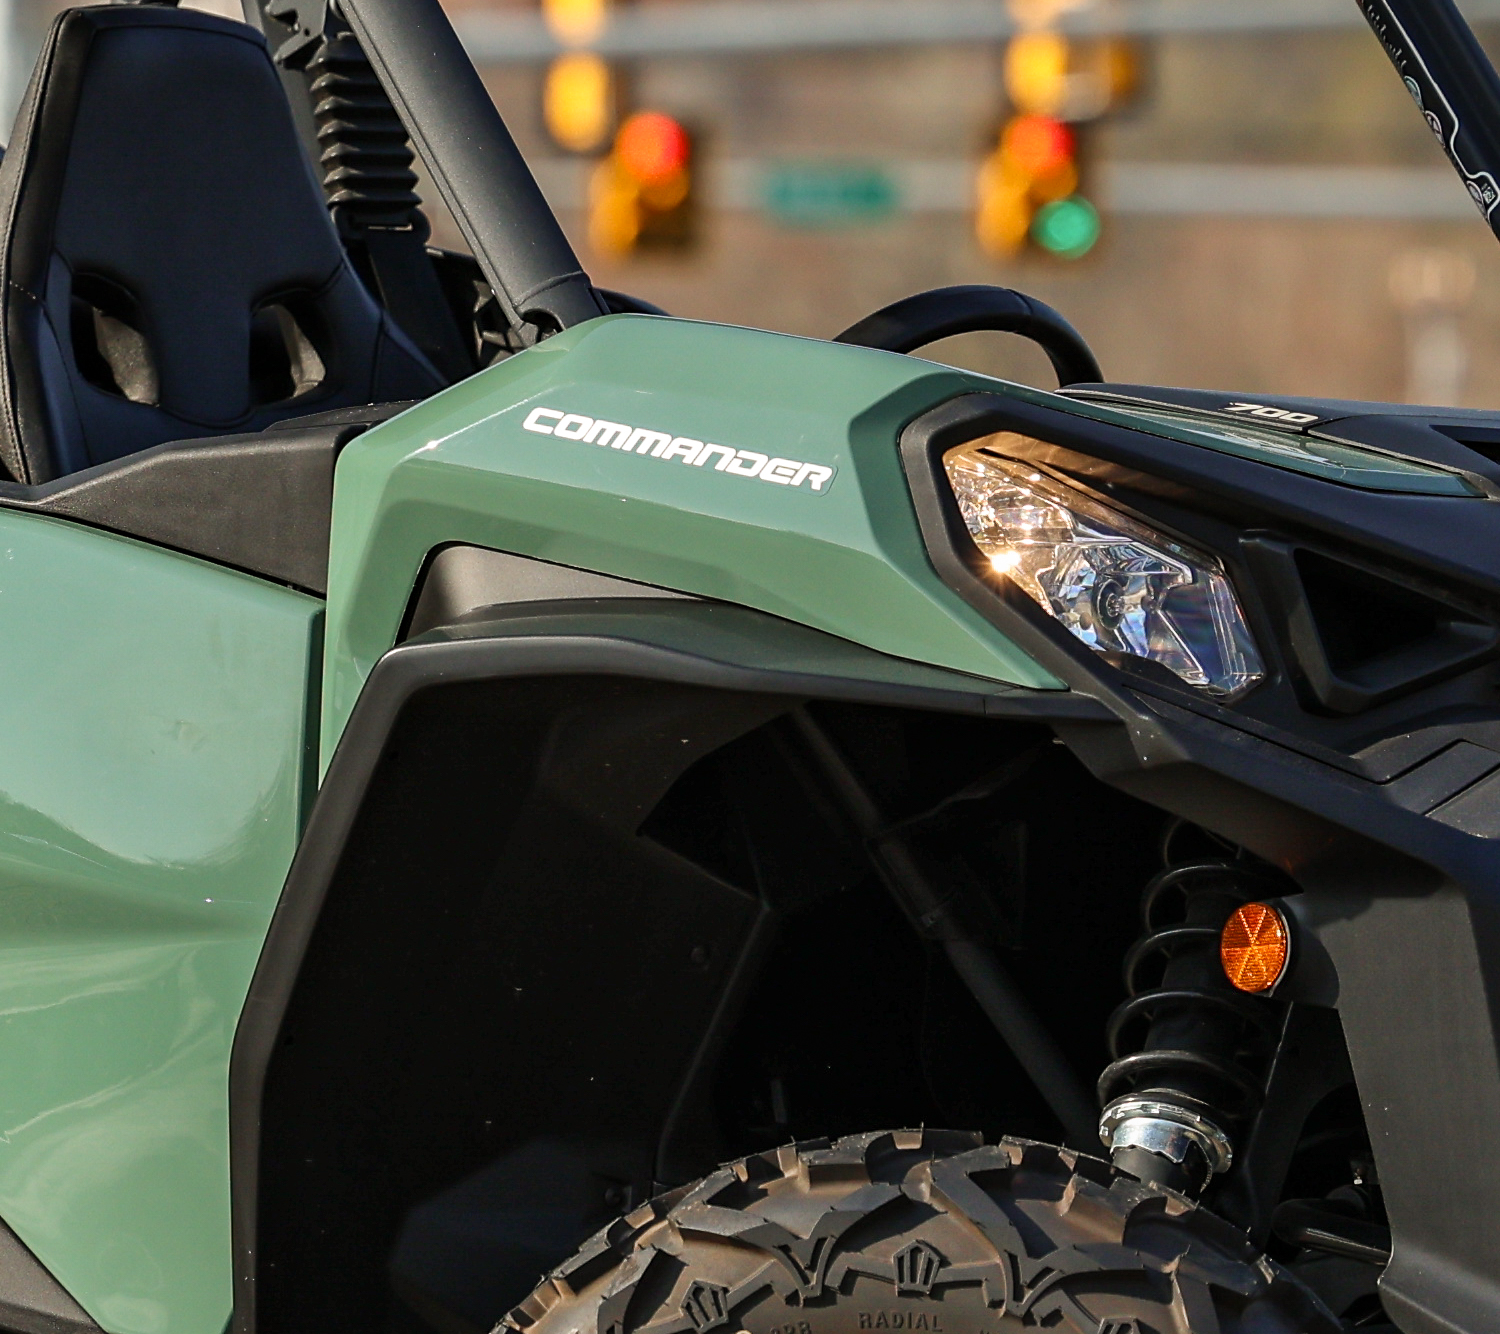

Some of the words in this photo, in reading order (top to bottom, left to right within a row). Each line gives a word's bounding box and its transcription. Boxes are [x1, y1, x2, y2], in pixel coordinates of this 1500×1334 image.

[1224, 402, 1319, 423] 700
[522, 406, 833, 491] COMMANDER
[857, 1310, 945, 1332] RADIAL
